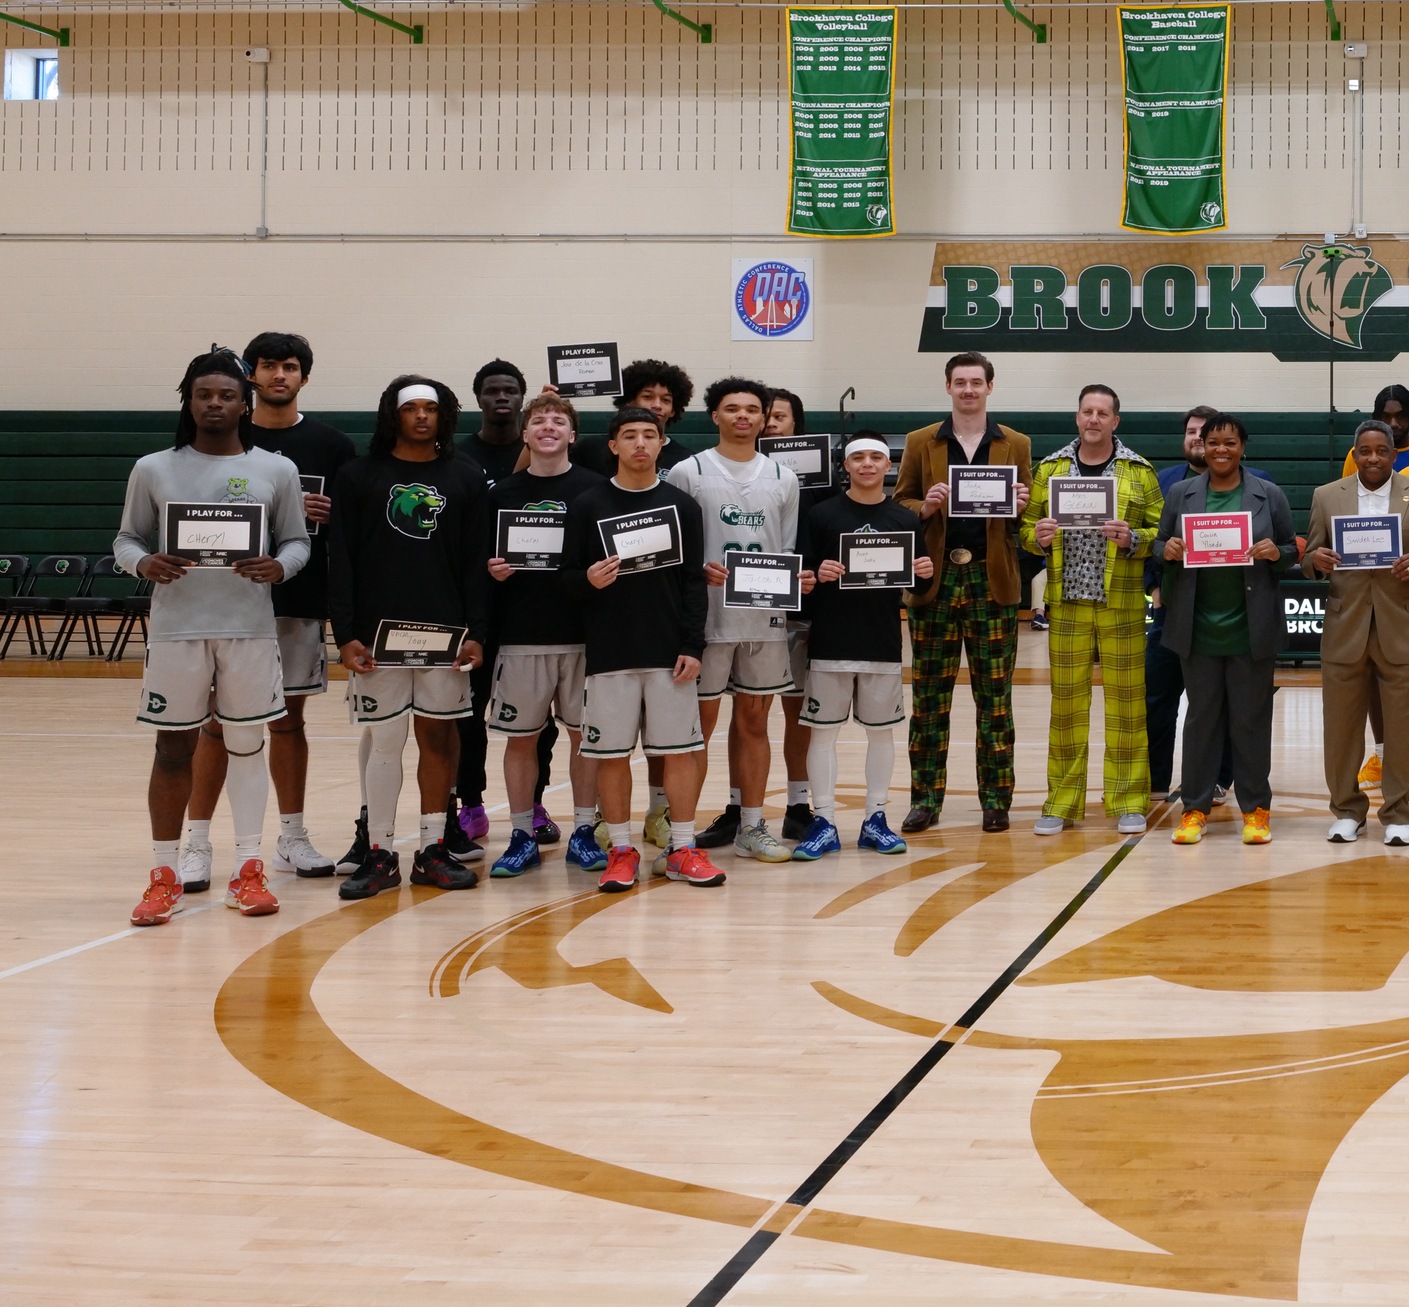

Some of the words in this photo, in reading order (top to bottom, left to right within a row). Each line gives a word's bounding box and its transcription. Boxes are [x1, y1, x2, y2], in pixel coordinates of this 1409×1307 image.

[855, 14, 893, 22] College
[748, 264, 789, 278] CONFERENCE
[753, 272, 806, 302] DAC
[738, 280, 747, 310] ATHLETIC
[942, 264, 1268, 331] BROOK
[742, 315, 763, 332] DALLAS
[621, 520, 638, 529] PLAY
[738, 516, 765, 526] BEARS
[1285, 599, 1327, 614] DAL
